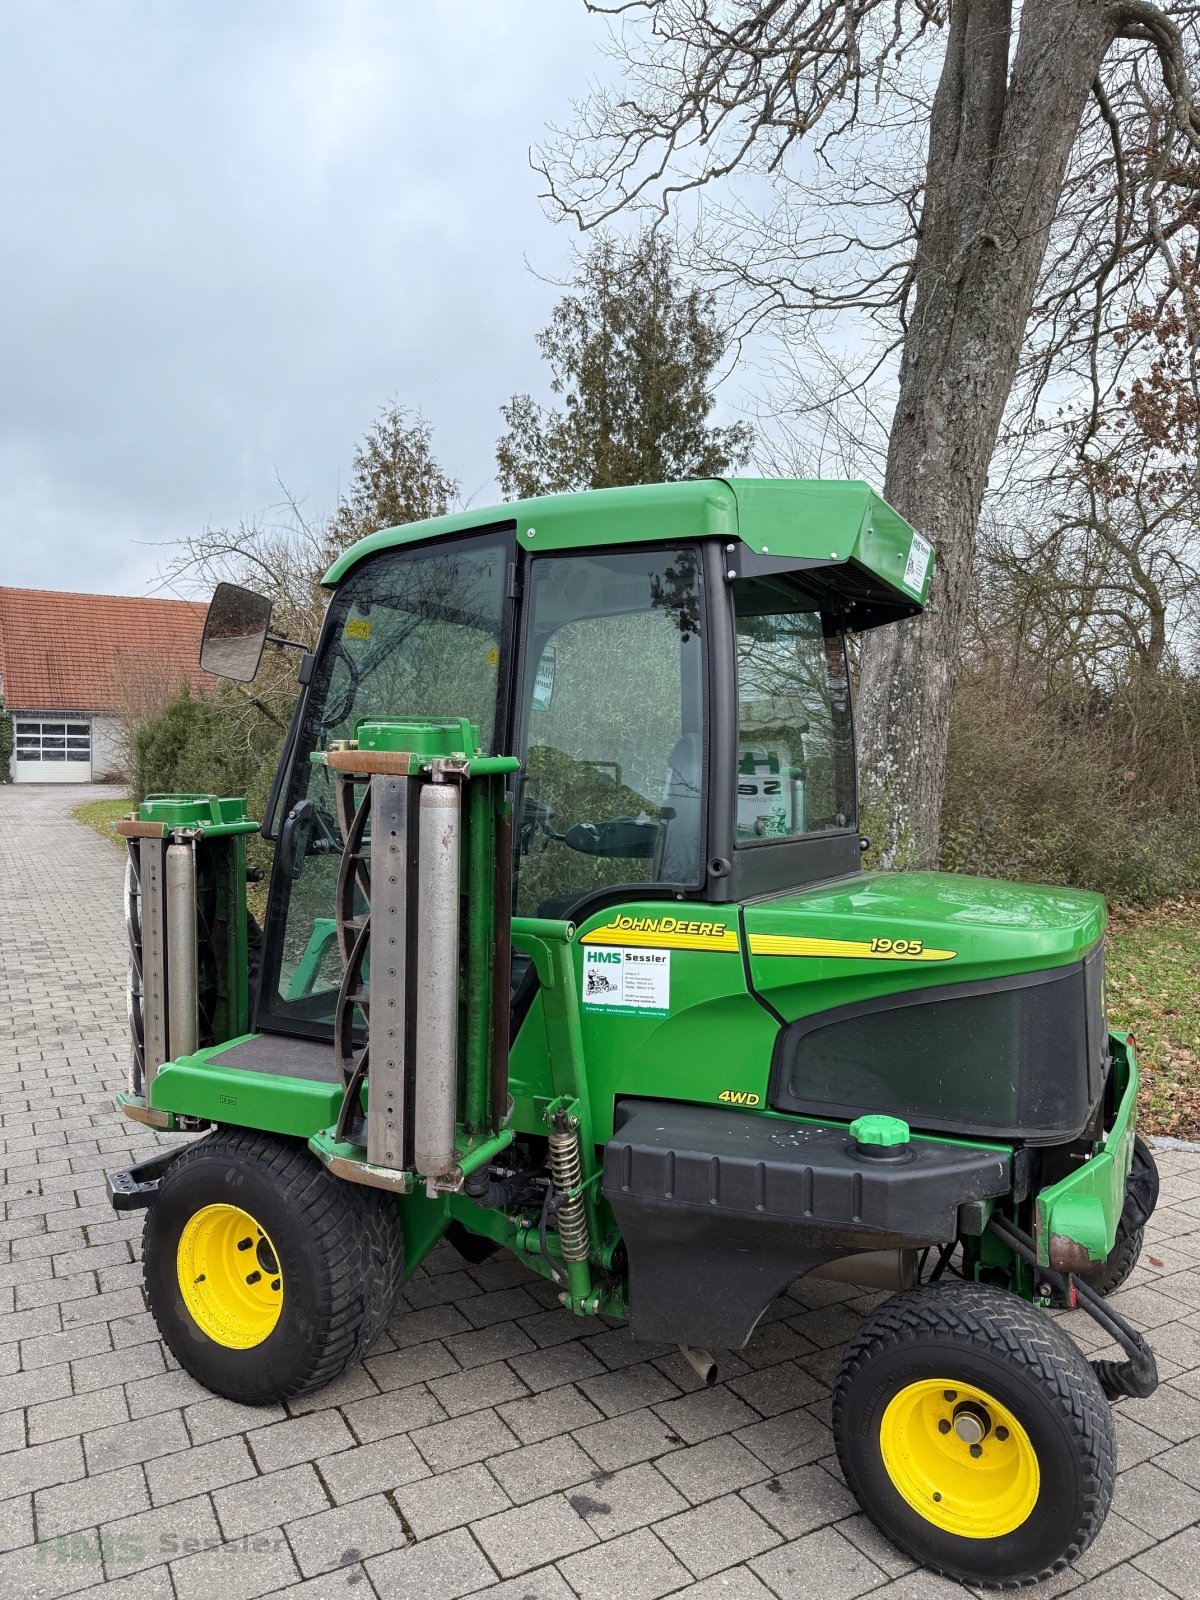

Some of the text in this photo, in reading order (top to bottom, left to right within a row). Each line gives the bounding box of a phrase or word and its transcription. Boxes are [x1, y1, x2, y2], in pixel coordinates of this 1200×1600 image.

[660, 917, 727, 937] DEERE
[870, 938, 923, 955] 1905
[587, 951, 667, 964] HMS Sessler
[718, 1090, 760, 1106] 4WD
